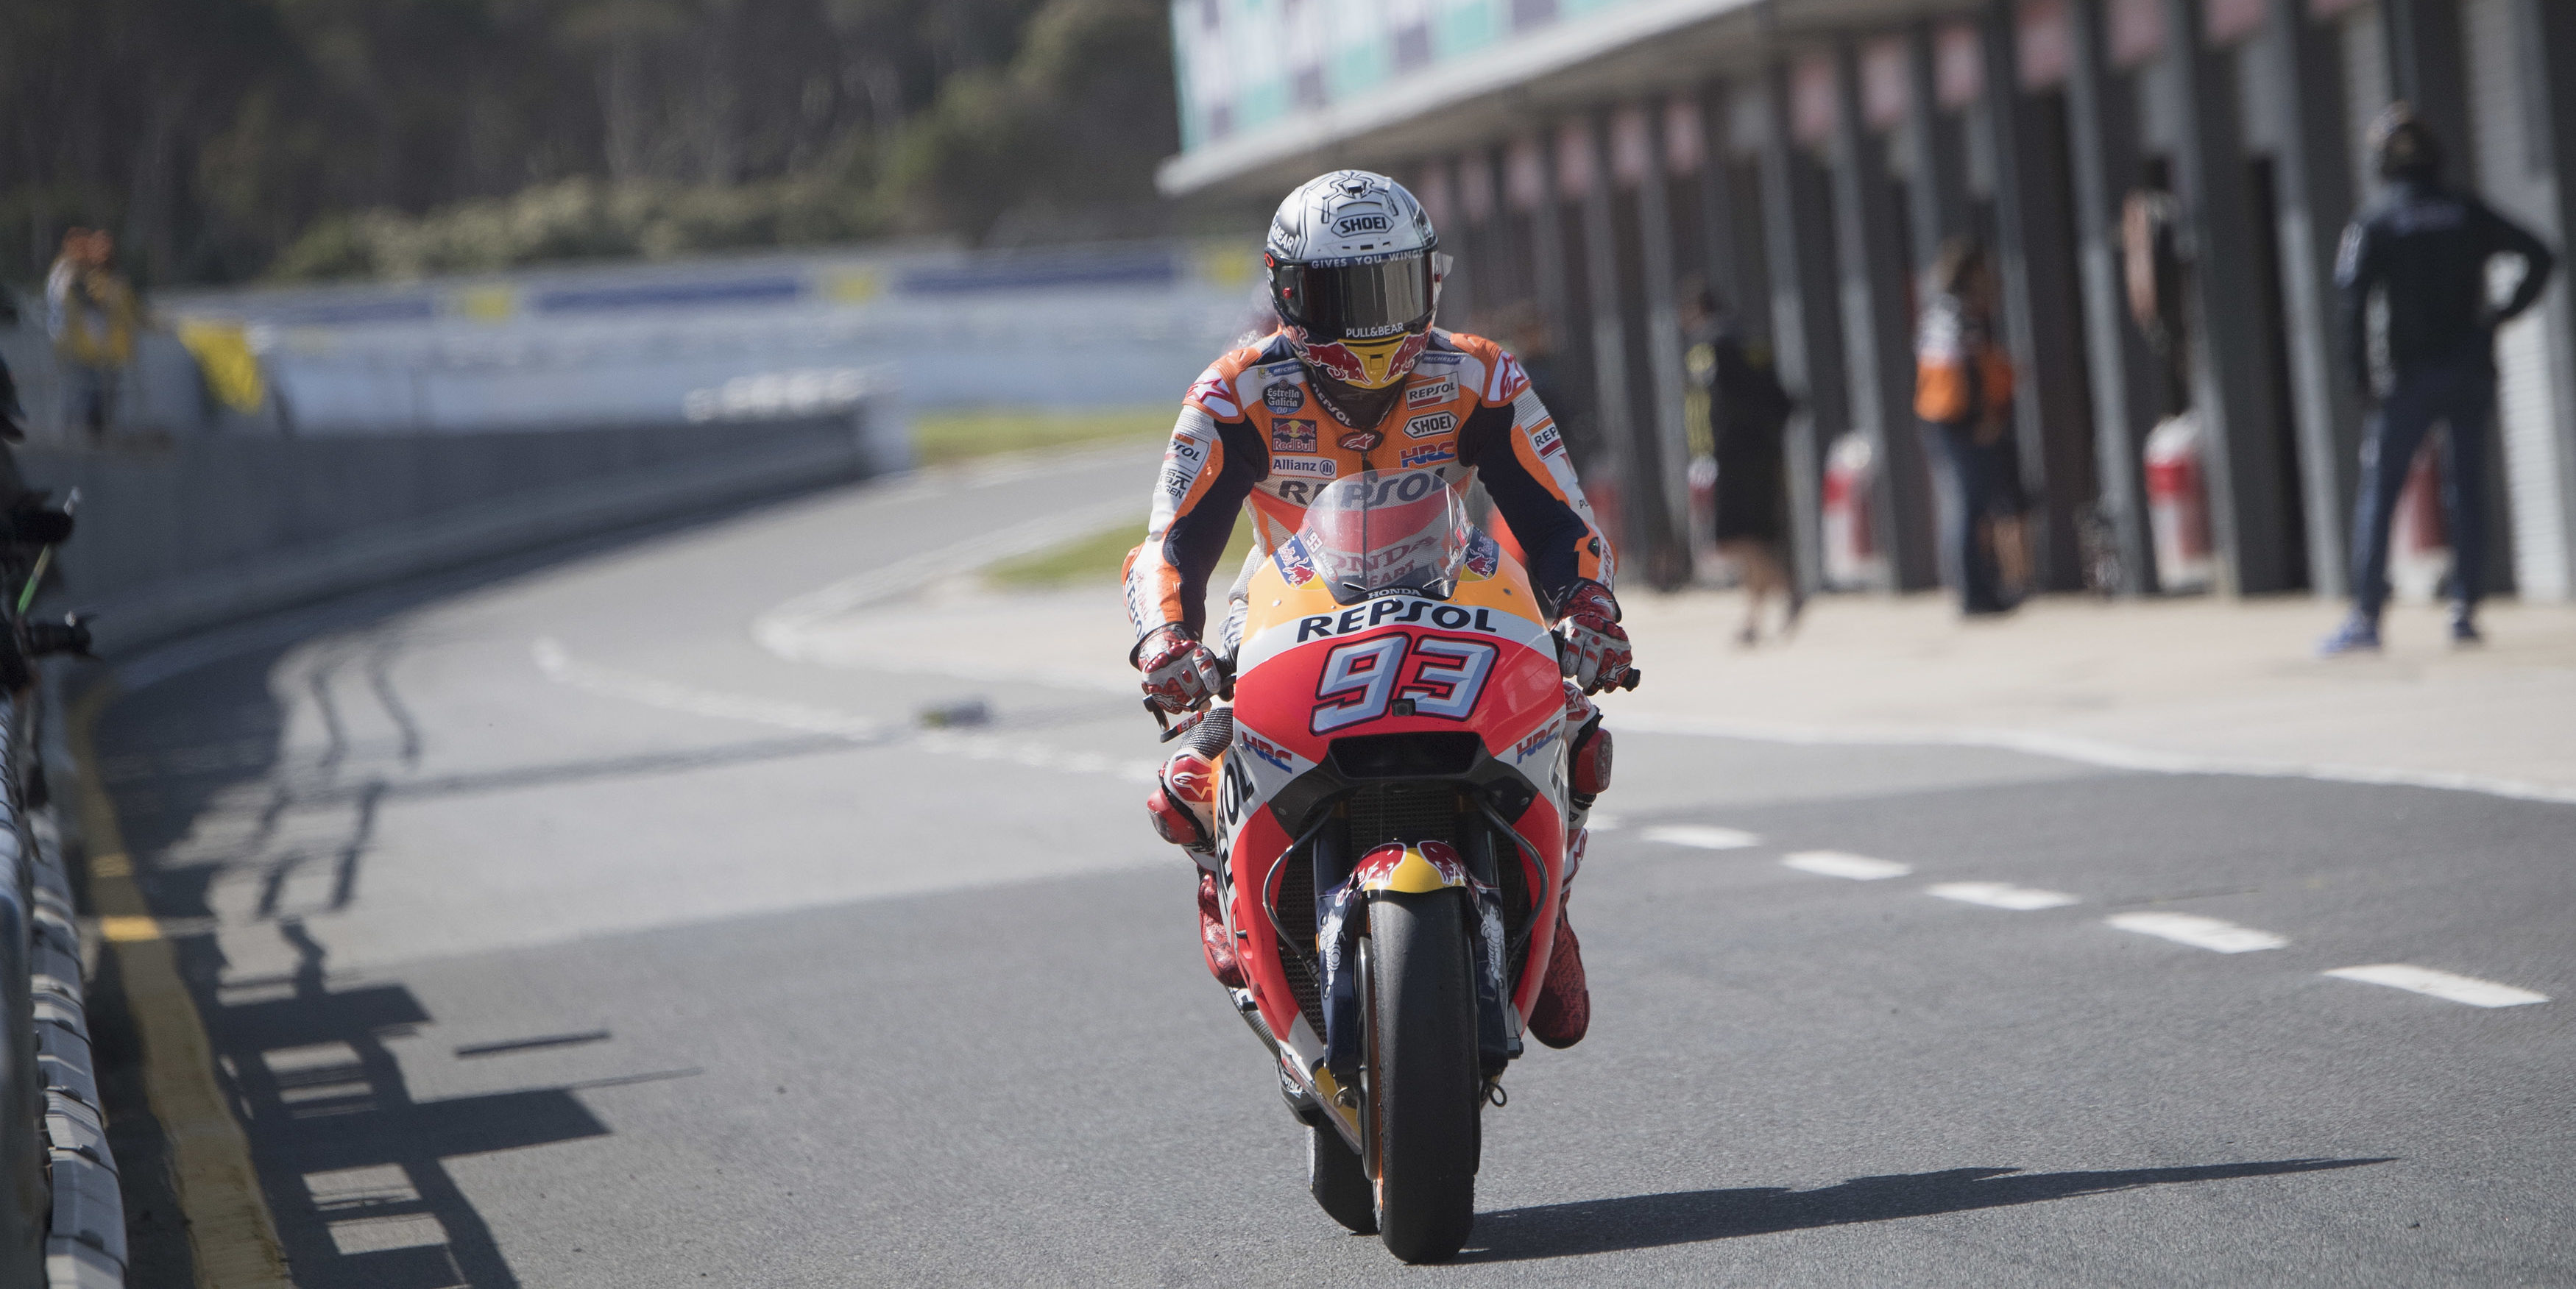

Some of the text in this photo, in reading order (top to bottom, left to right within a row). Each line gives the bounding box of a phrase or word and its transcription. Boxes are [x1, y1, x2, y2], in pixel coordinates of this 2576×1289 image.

[1340, 217, 1387, 233] SHOEI
[1312, 249, 1424, 269] GIVES YOU WINGS
[1345, 322, 1404, 338] PULL&BEAR
[1273, 364, 1301, 374] MICHEL
[1267, 388, 1300, 398] Estrella
[1409, 382, 1455, 400] REPSOL
[1267, 397, 1298, 408] Galicia
[1411, 415, 1451, 435] SHOEI
[1273, 438, 1316, 452] Red Bull
[1534, 427, 1559, 447] REP
[1273, 458, 1317, 471] Allianz
[1400, 441, 1455, 469] HRC
[1306, 531, 1323, 553] 93
[1367, 559, 1415, 588] EART
[1368, 589, 1423, 600] HONDA
[1297, 599, 1496, 643] REPSOL
[1309, 631, 1500, 735] 93
[1179, 714, 1198, 733] 93
[1242, 731, 1292, 774] HRC
